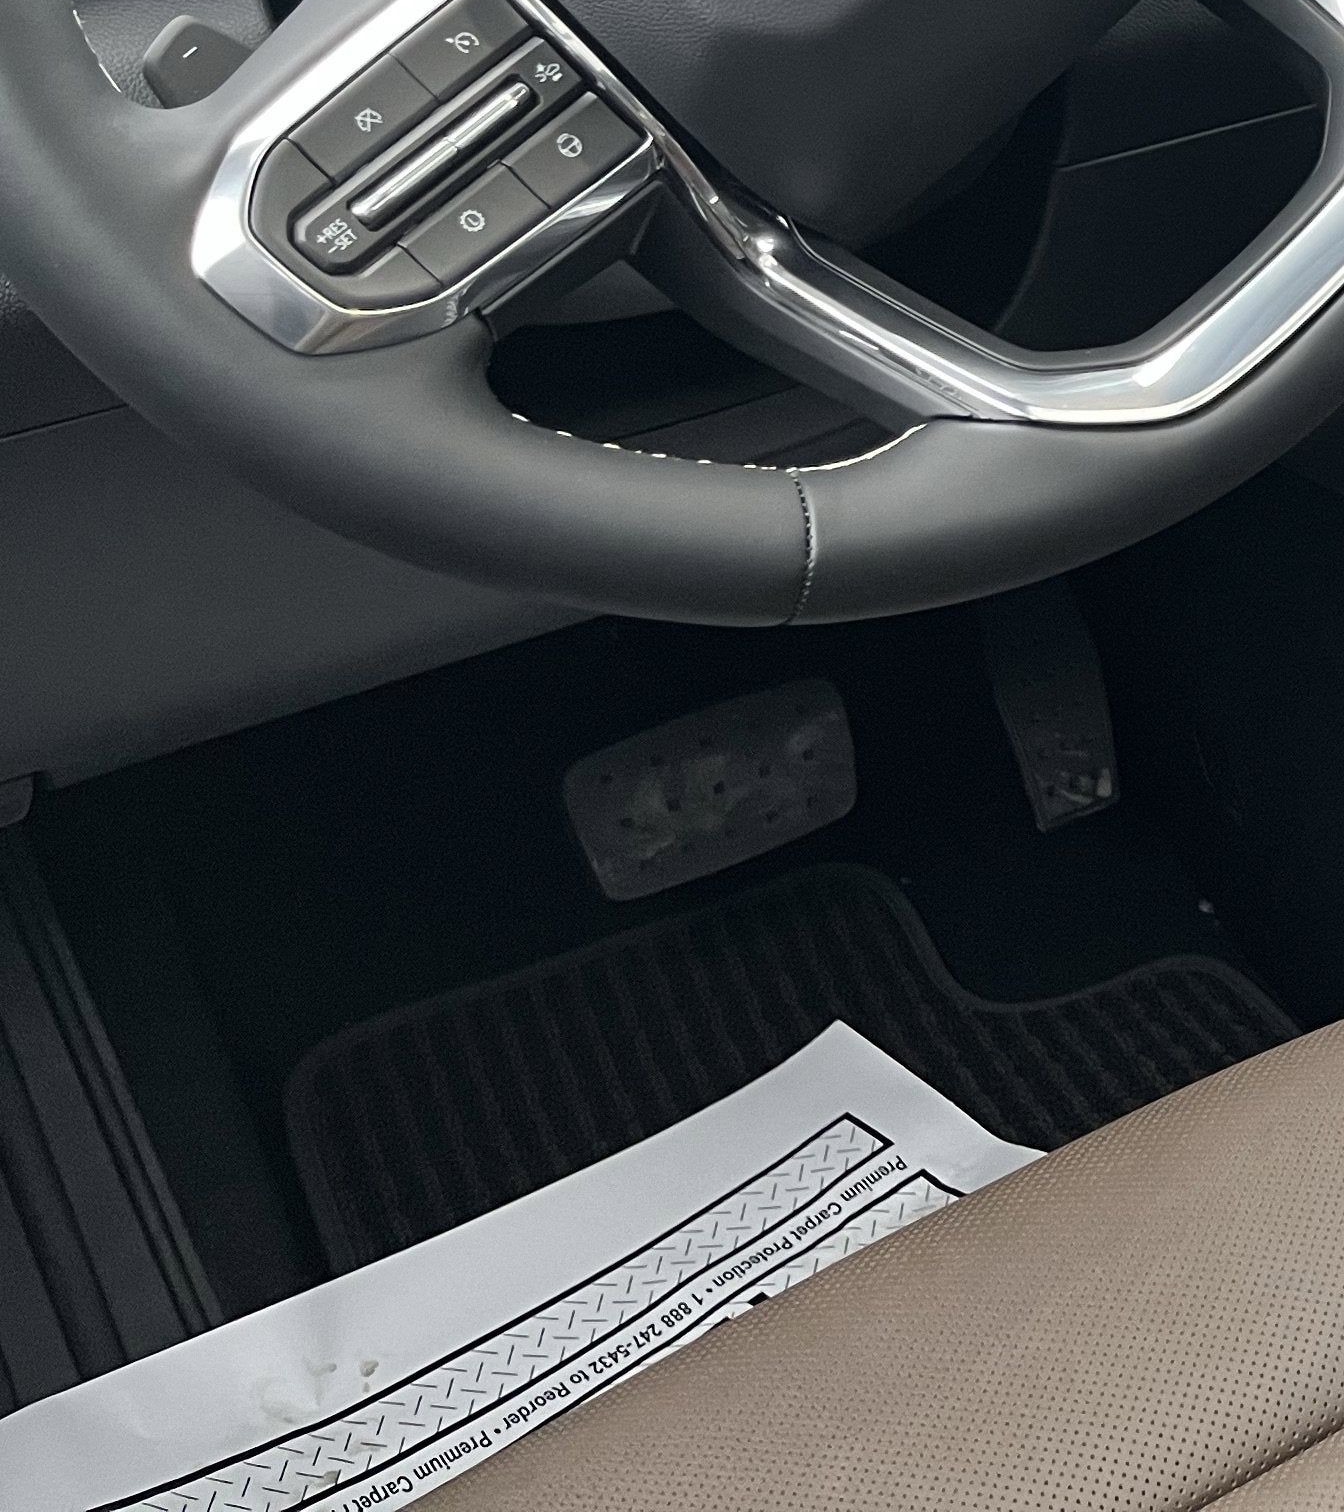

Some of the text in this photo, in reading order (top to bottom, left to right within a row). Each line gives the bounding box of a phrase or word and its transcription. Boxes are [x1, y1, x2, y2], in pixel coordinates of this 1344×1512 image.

[316, 218, 348, 244] +RES
[840, 1155, 908, 1202] Premium
[794, 1201, 842, 1242] Carpet
[712, 1235, 793, 1286] Protection
[660, 1302, 692, 1328] 888
[691, 1292, 704, 1306] 1
[590, 1323, 662, 1375] 247-5432
[569, 1369, 590, 1385] to
[502, 1383, 572, 1430] Reorder
[413, 1432, 493, 1481] Premium
